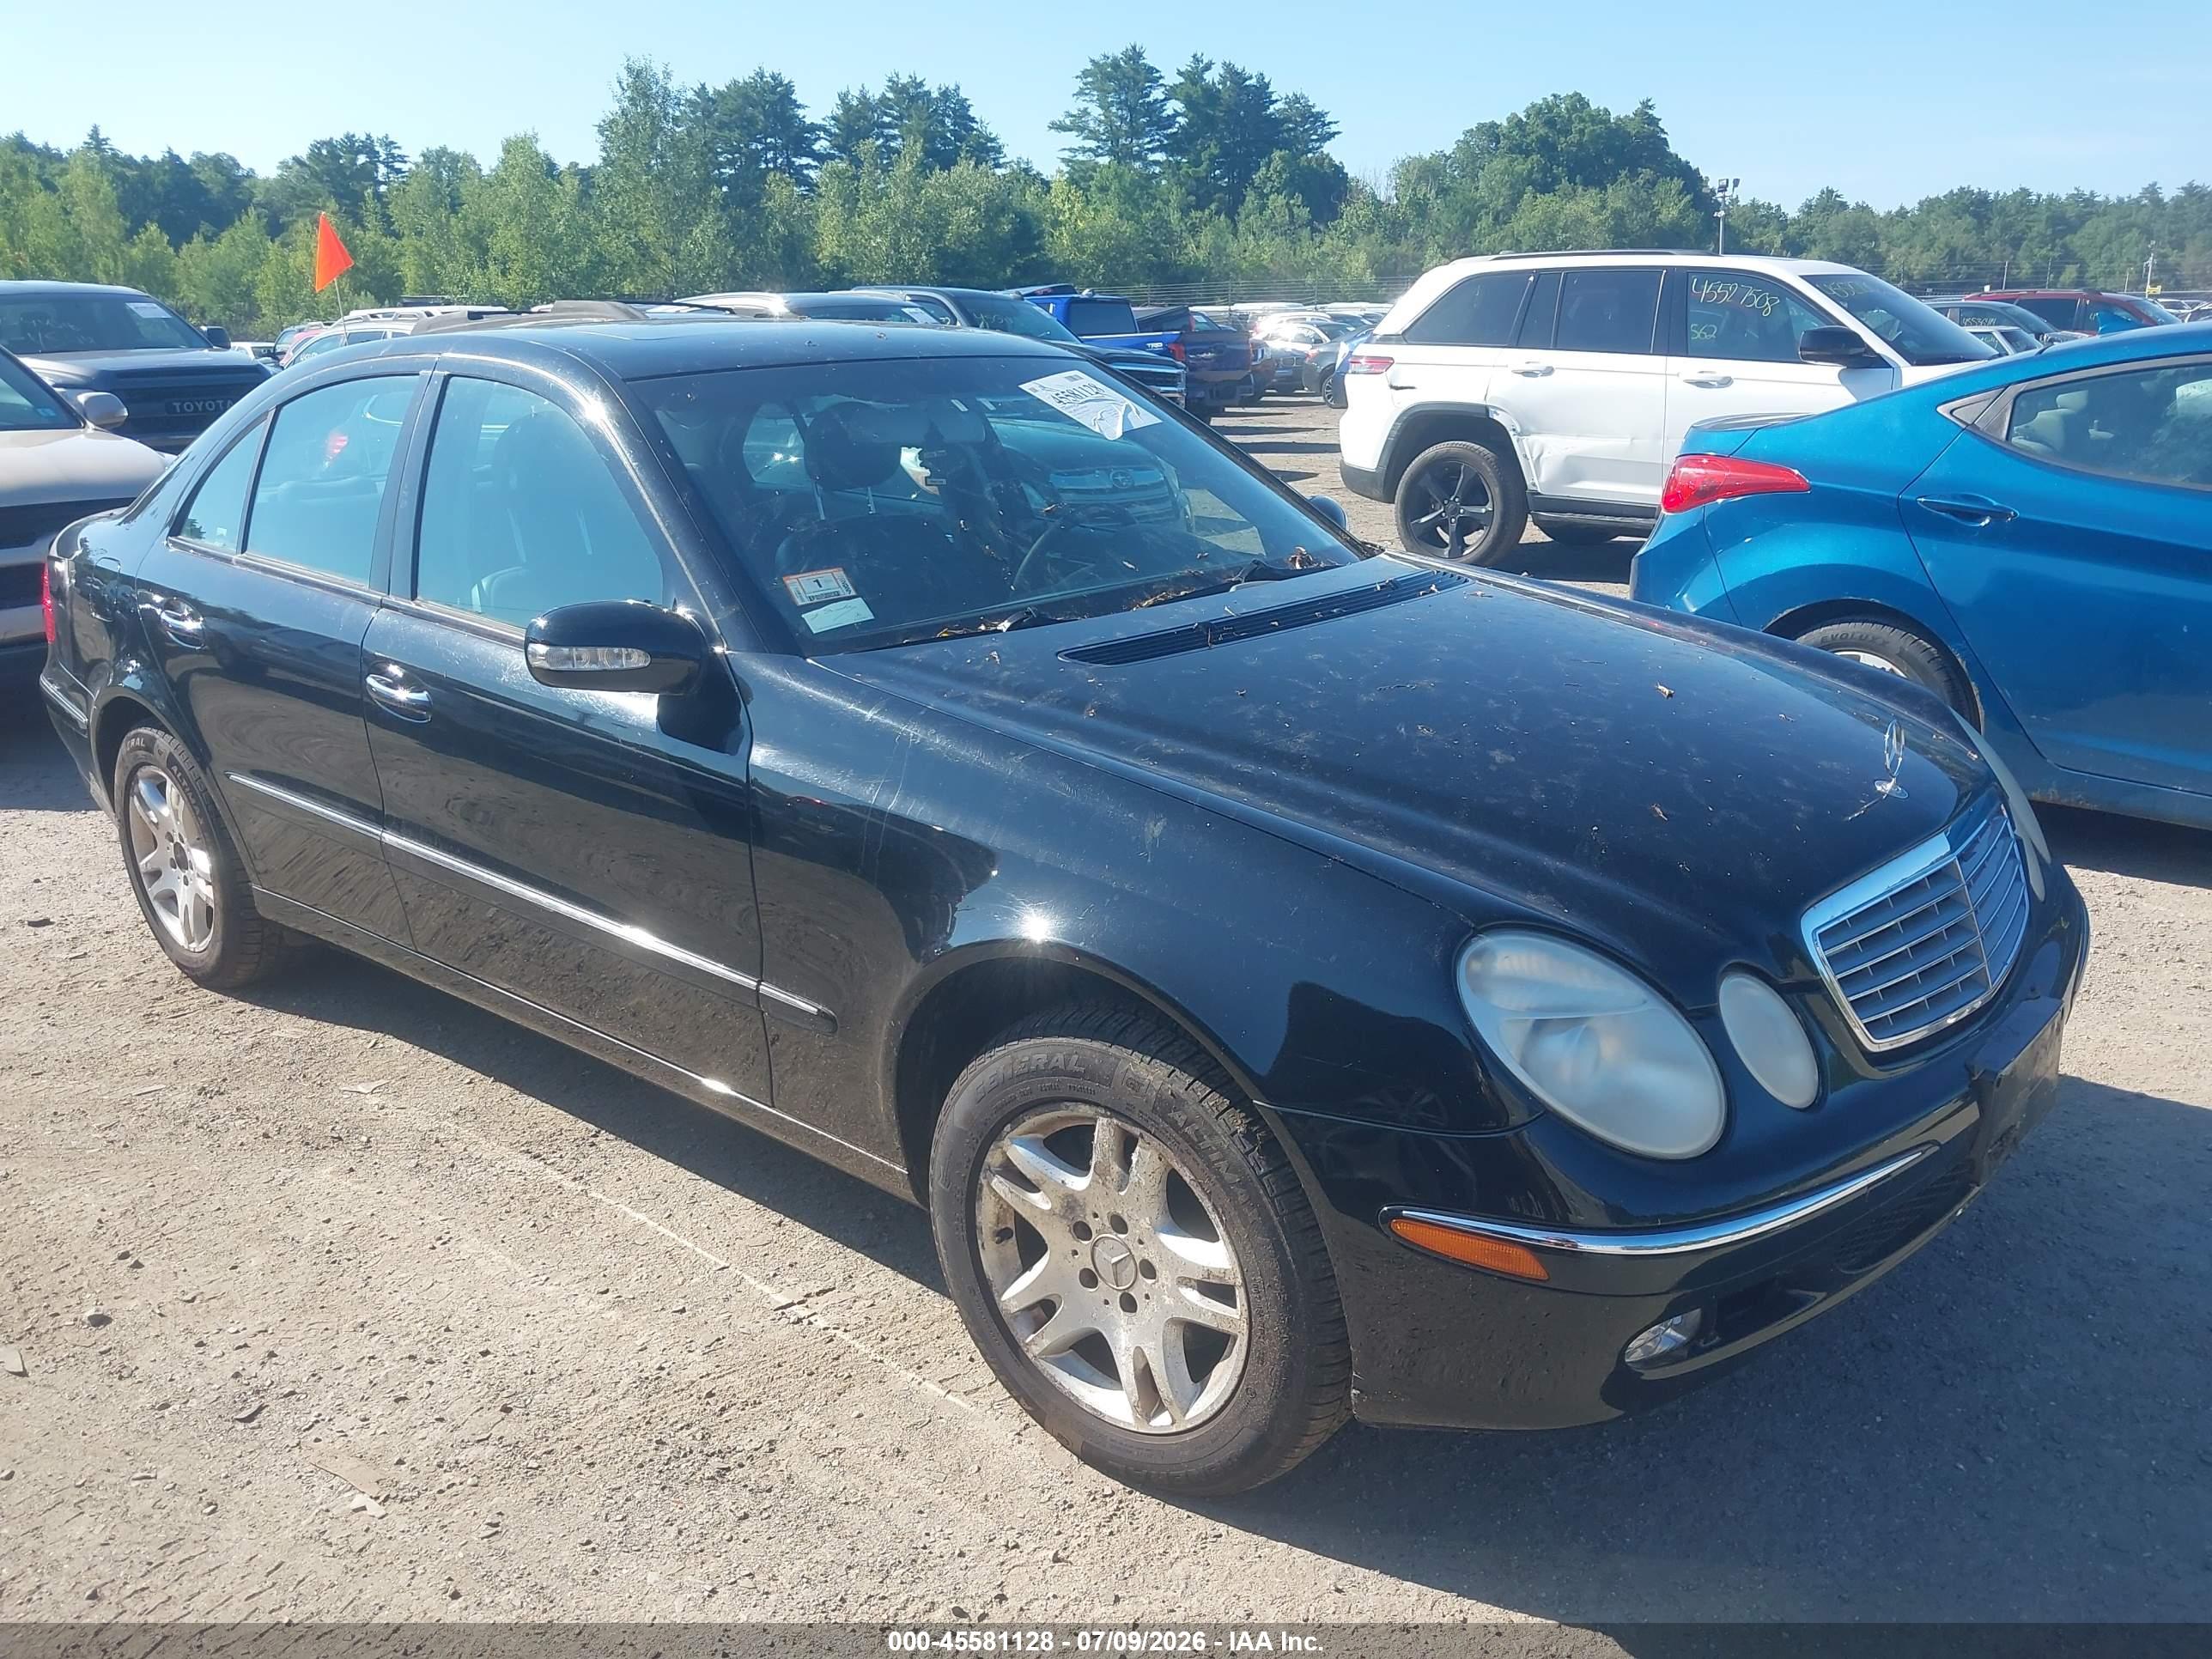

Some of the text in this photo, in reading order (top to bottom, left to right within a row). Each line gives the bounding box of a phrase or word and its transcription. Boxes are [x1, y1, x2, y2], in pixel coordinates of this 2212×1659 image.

[1692, 277, 1780, 317] 45527508
[1050, 383, 1105, 404] 45581128
[173, 399, 233, 413] TOYOTA
[812, 579, 823, 589] 1
